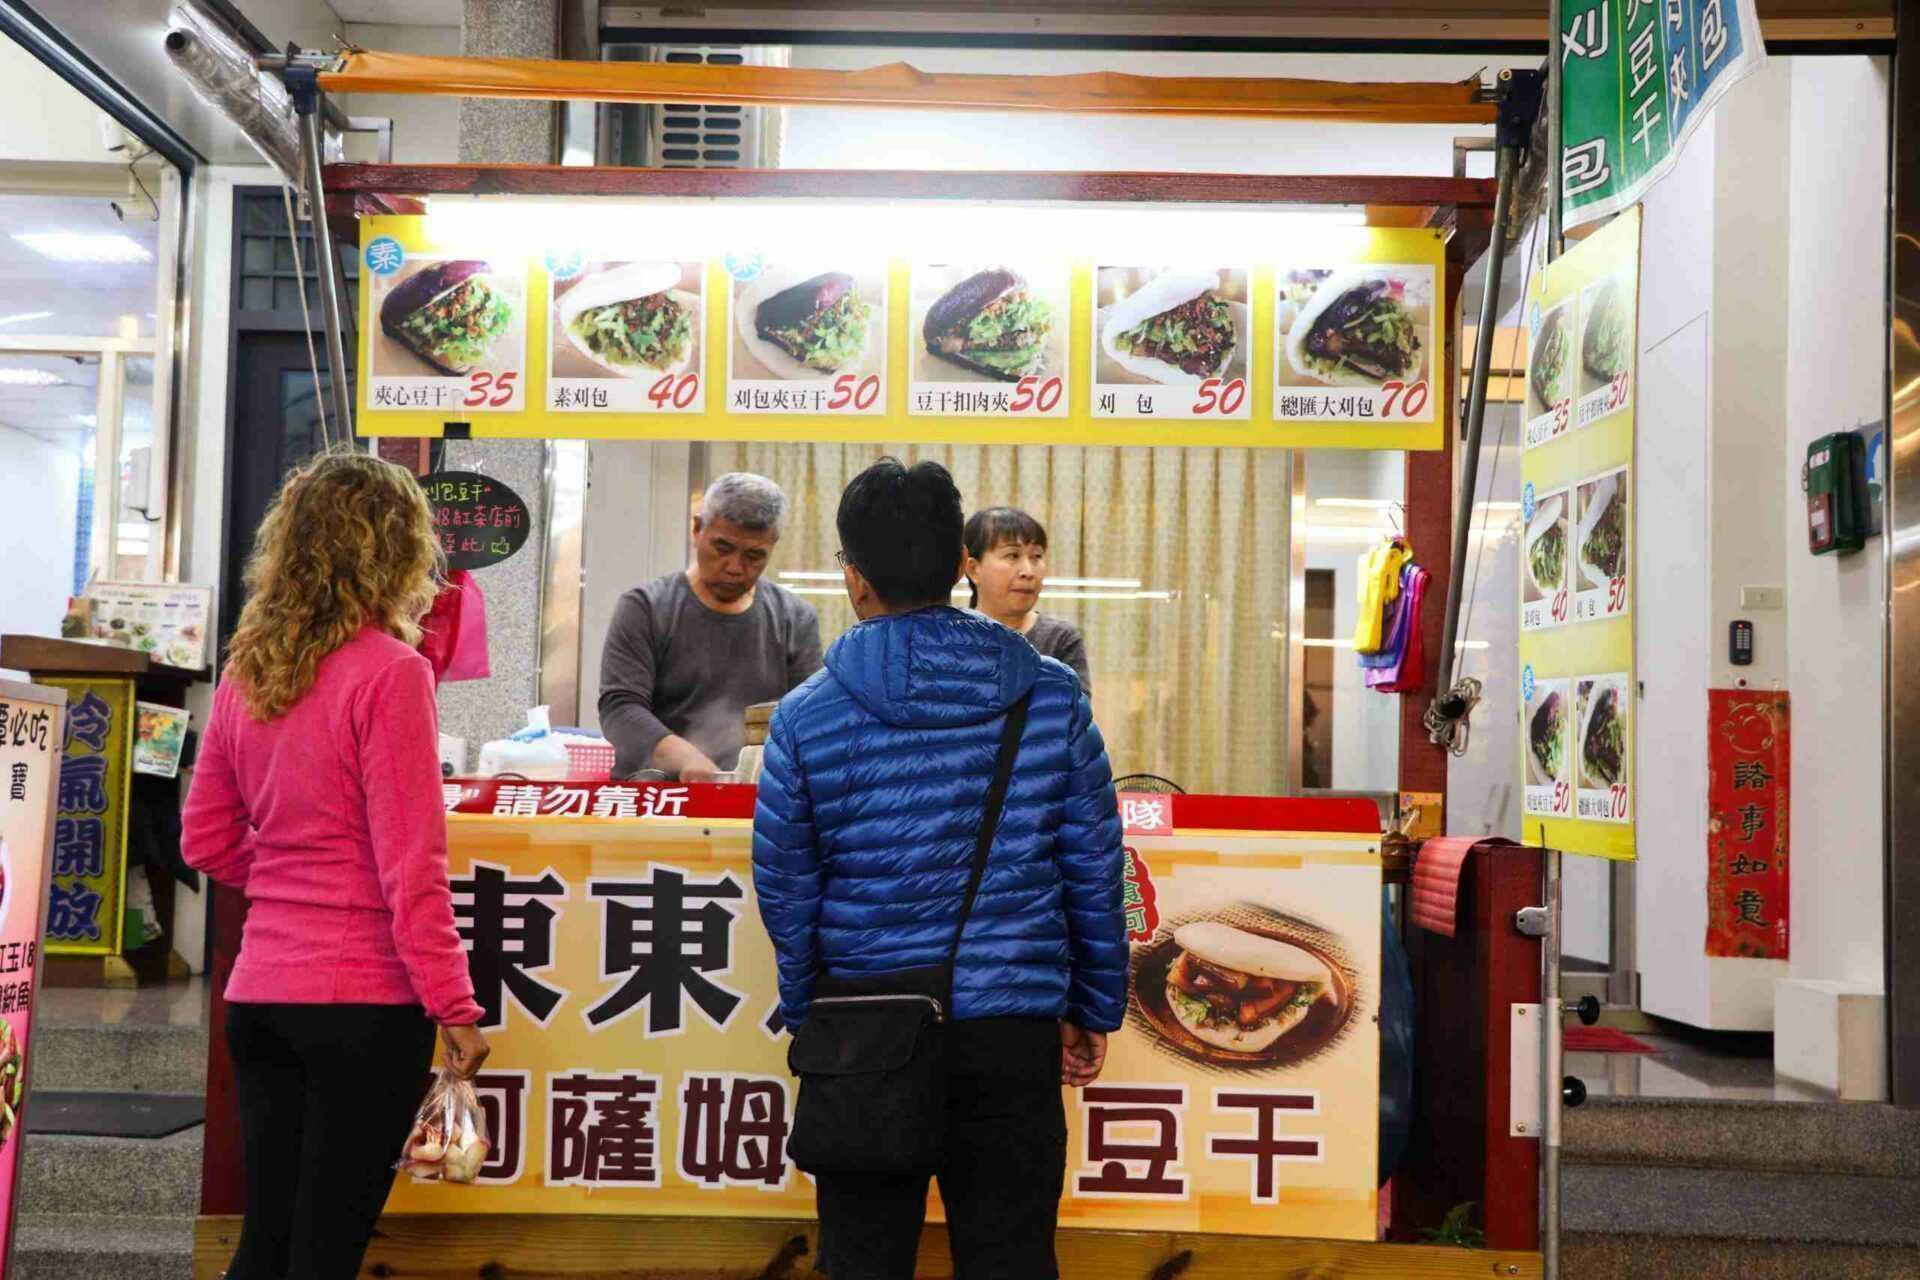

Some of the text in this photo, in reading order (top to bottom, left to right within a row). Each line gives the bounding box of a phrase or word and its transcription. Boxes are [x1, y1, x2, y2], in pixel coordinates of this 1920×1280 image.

[1626, 0, 1661, 159] 豆干
[369, 242, 400, 273] 素
[463, 371, 517, 407] 35
[554, 374, 699, 409] 素刈包 40
[735, 375, 881, 410] 刈包夾豆干 50
[916, 376, 1063, 413] 豆干扣肉夾 50
[1192, 378, 1245, 415] 50
[1281, 380, 1428, 418] 總匯大刈包 70
[1608, 371, 1628, 410] 50
[1552, 399, 1570, 435] 35
[432, 505, 520, 528] 18紅茶店前
[1552, 587, 1567, 624] 40
[1608, 576, 1625, 612] 50
[492, 784, 690, 819] 請勿靠近
[1553, 782, 1569, 814] 50
[1610, 784, 1627, 818] 70
[1728, 761, 1774, 927] 諸事如意
[449, 864, 785, 1036] 東東
[1078, 1087, 1318, 1198] 豆干
